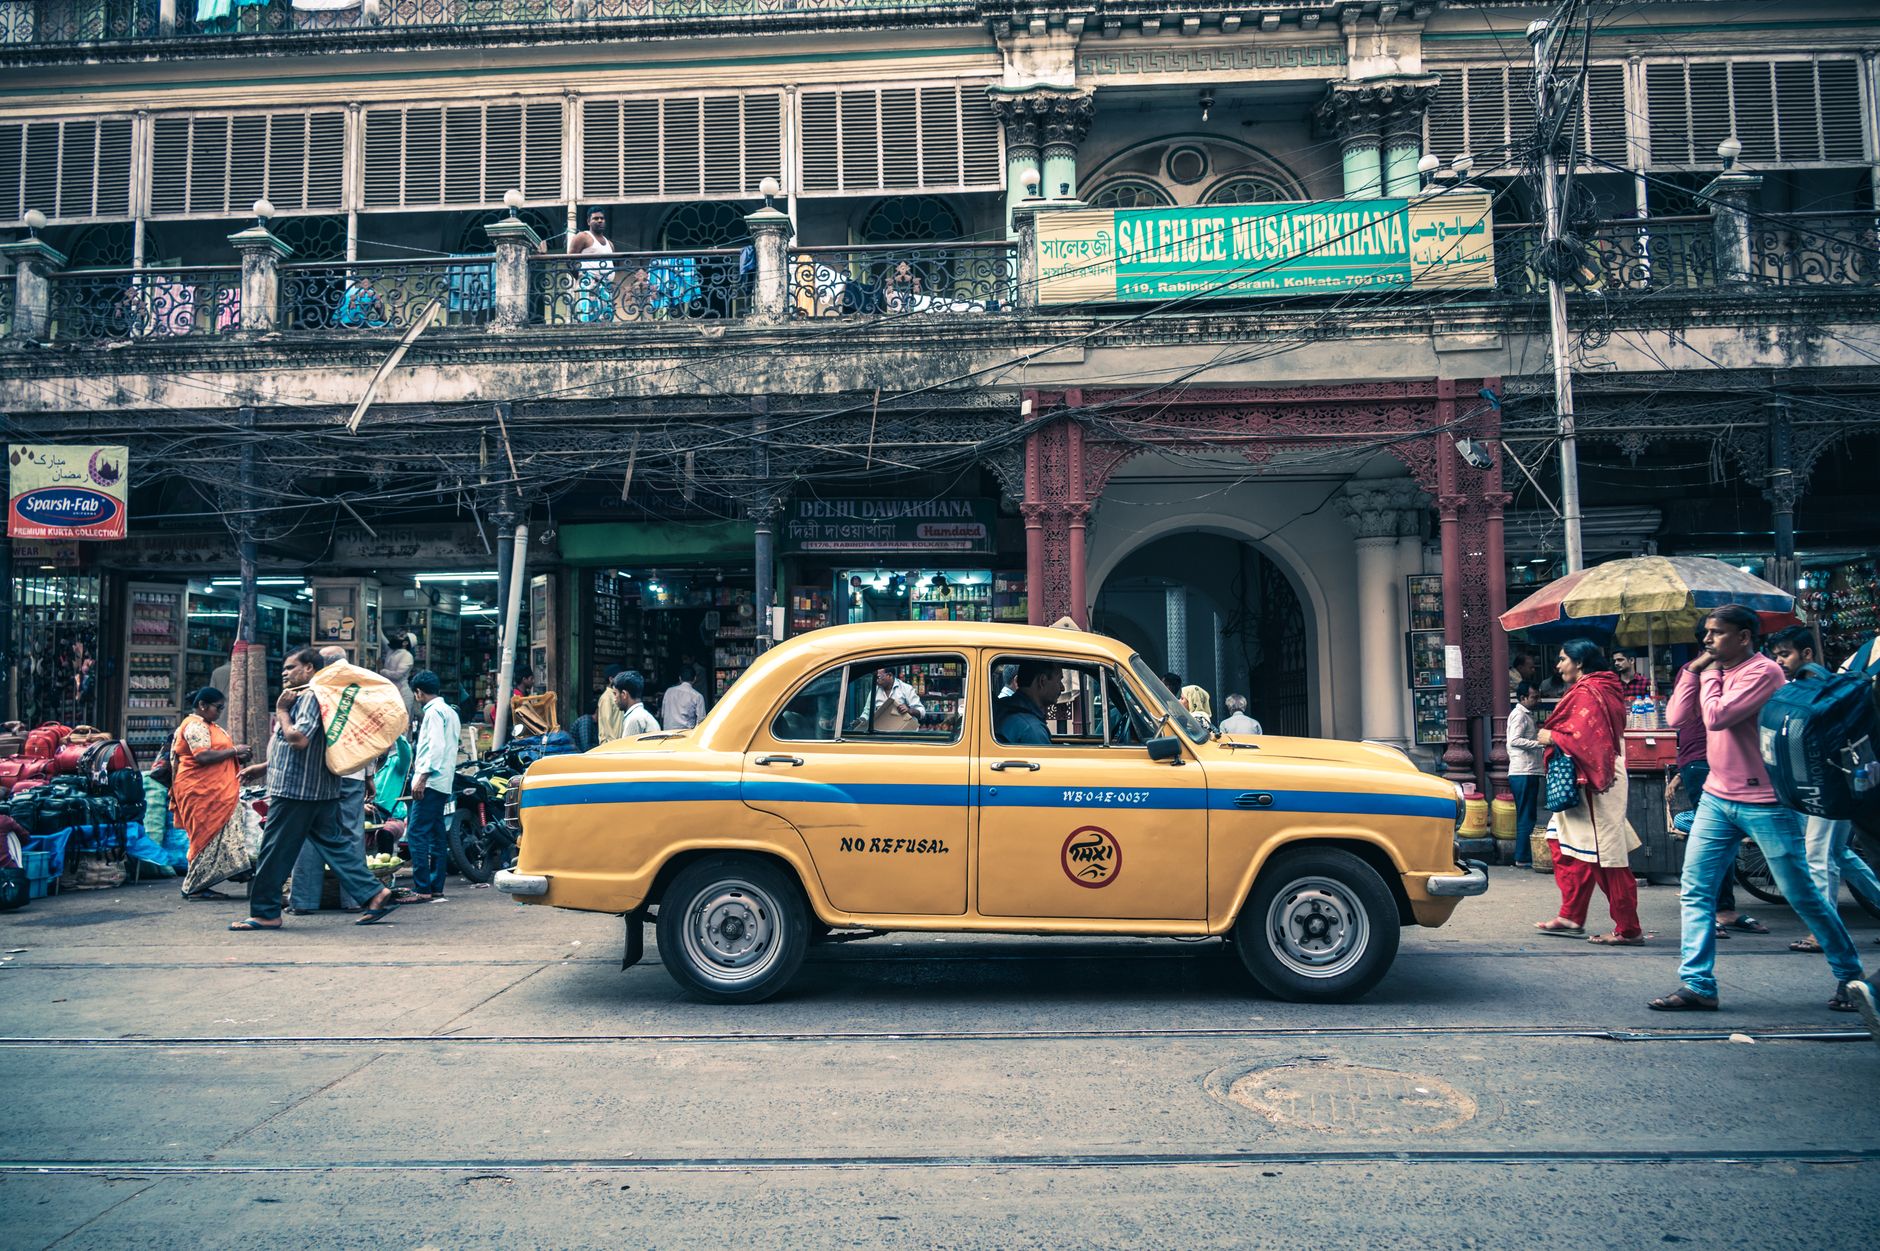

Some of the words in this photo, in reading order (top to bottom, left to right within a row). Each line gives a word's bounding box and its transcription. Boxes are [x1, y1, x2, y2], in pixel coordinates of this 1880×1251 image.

[1041, 231, 1112, 260] সালেহজী
[1118, 217, 1227, 264] SALEHJEE
[1231, 210, 1406, 261] MUSAFIRKHANA
[1122, 283, 1154, 294] 119,
[1158, 281, 1222, 292] Rabindra
[1284, 275, 1372, 287] Kolkata-700
[1376, 273, 1404, 284] 073
[26, 496, 99, 513] Sparsh-Fab
[801, 501, 856, 517] DELHI
[862, 501, 973, 517] DAWAKHANA
[14, 527, 47, 535] PREMIUM
[48, 527, 74, 536] KURTA
[75, 528, 119, 537] COLLECTION
[924, 525, 981, 537] Hamdard
[840, 837, 866, 853] NO
[869, 837, 949, 854] REFUSAL
[1069, 833, 1113, 862] TAXI
